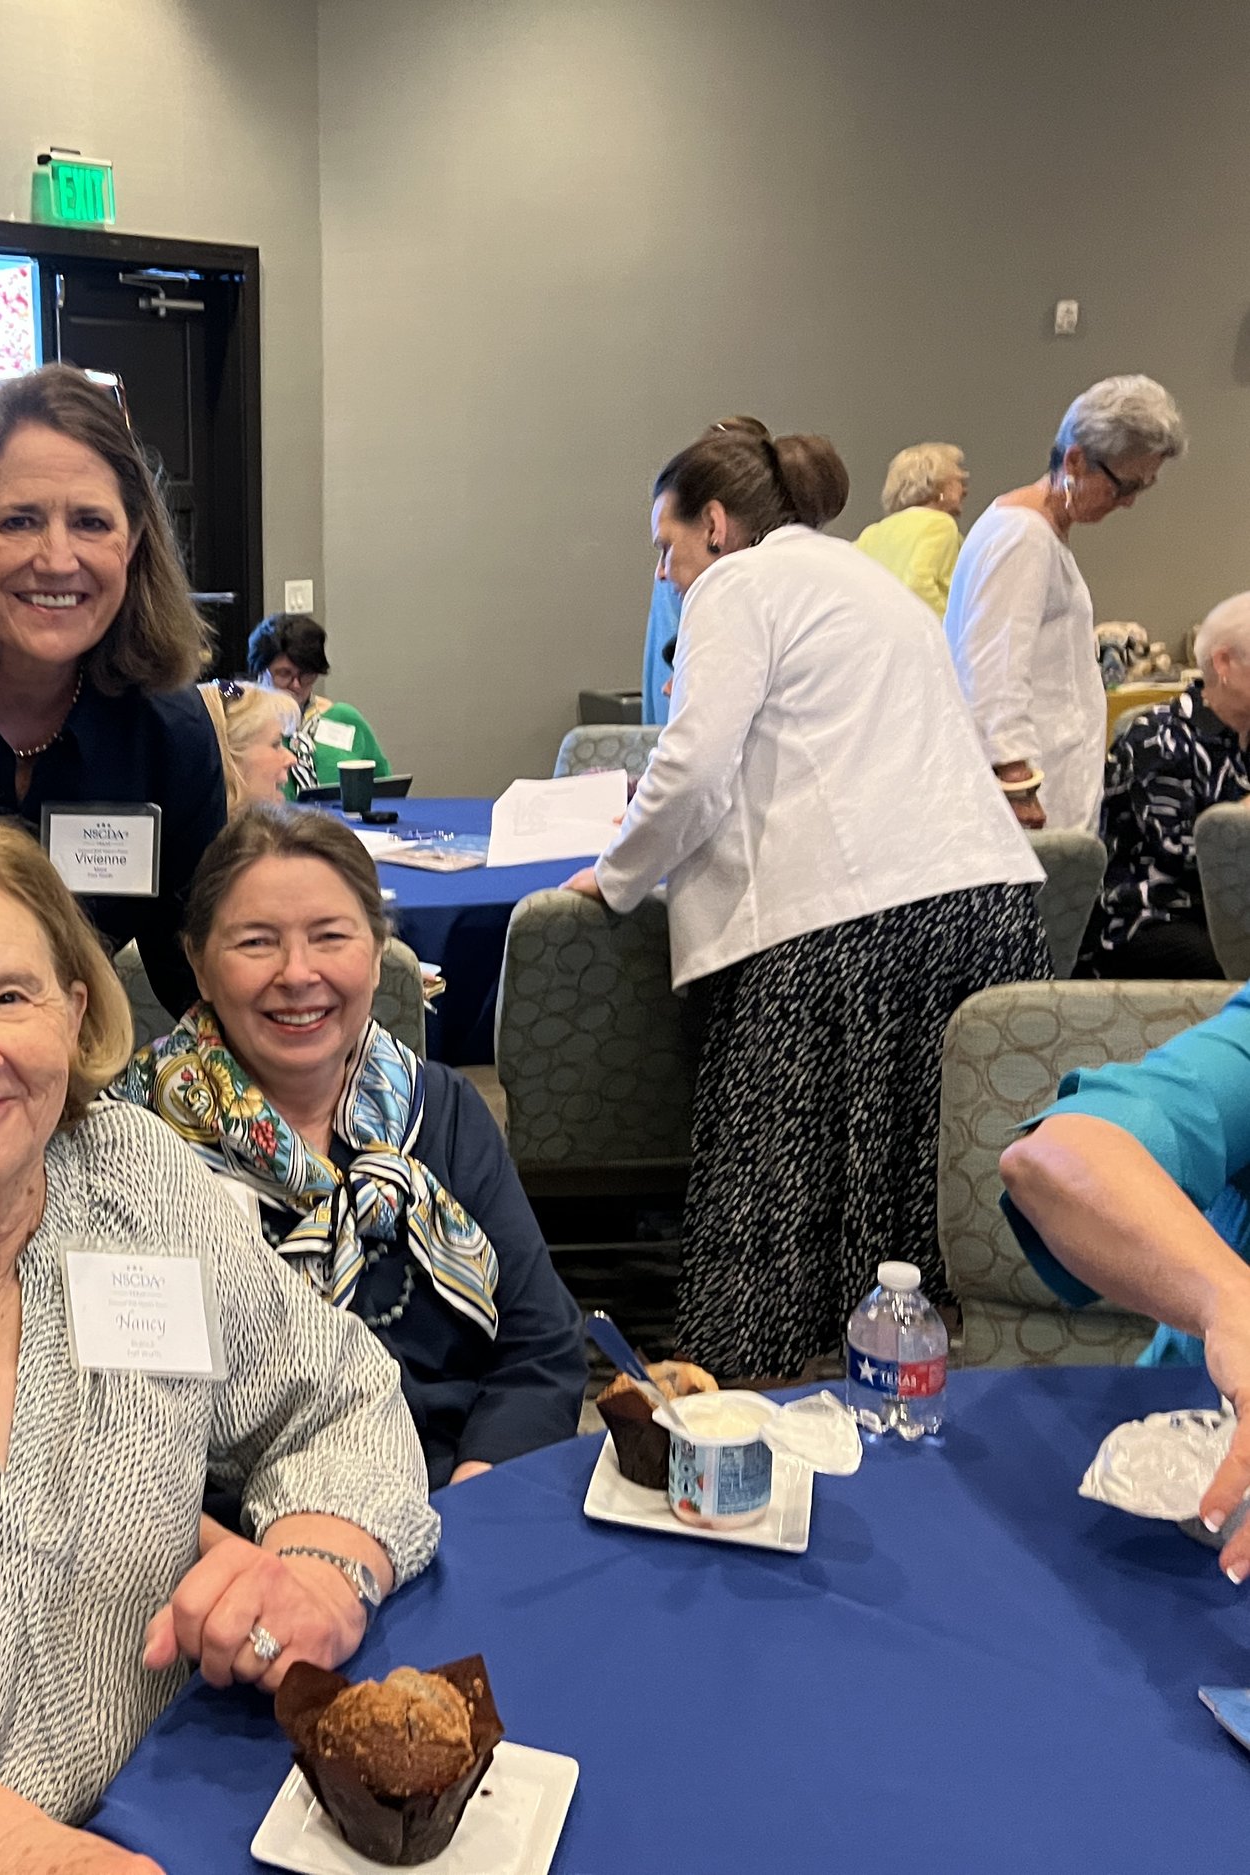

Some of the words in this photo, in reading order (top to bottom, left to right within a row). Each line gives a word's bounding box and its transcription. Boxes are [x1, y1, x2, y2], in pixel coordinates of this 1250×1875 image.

[58, 166, 104, 222] EXIT
[75, 852, 127, 866] Vivienne
[115, 1310, 166, 1339] Nancy
